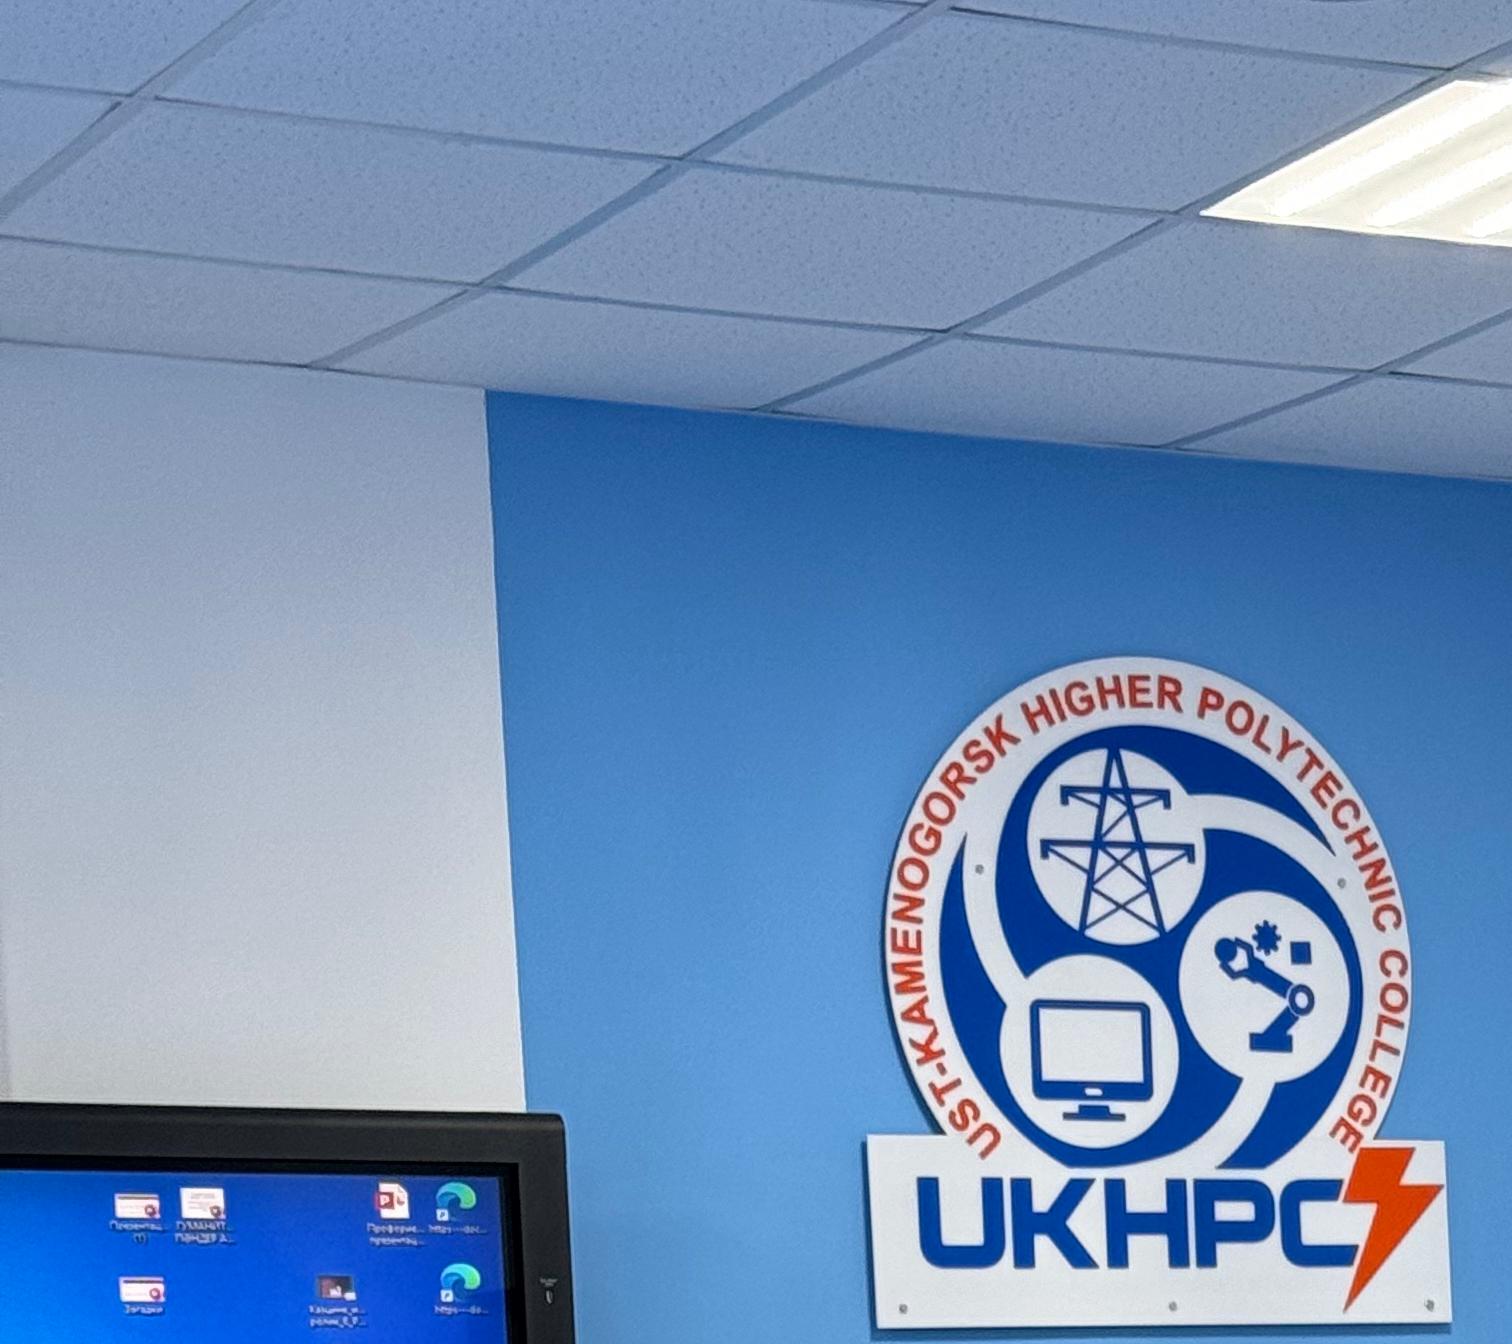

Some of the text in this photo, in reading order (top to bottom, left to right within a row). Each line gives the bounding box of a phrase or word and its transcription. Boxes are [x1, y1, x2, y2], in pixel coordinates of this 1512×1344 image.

[890, 674, 1408, 1159] UST-KAMENOGORSK HIGHER POLYTECHNIC COLLEGE
[916, 1176, 1361, 1269] UKHPC
